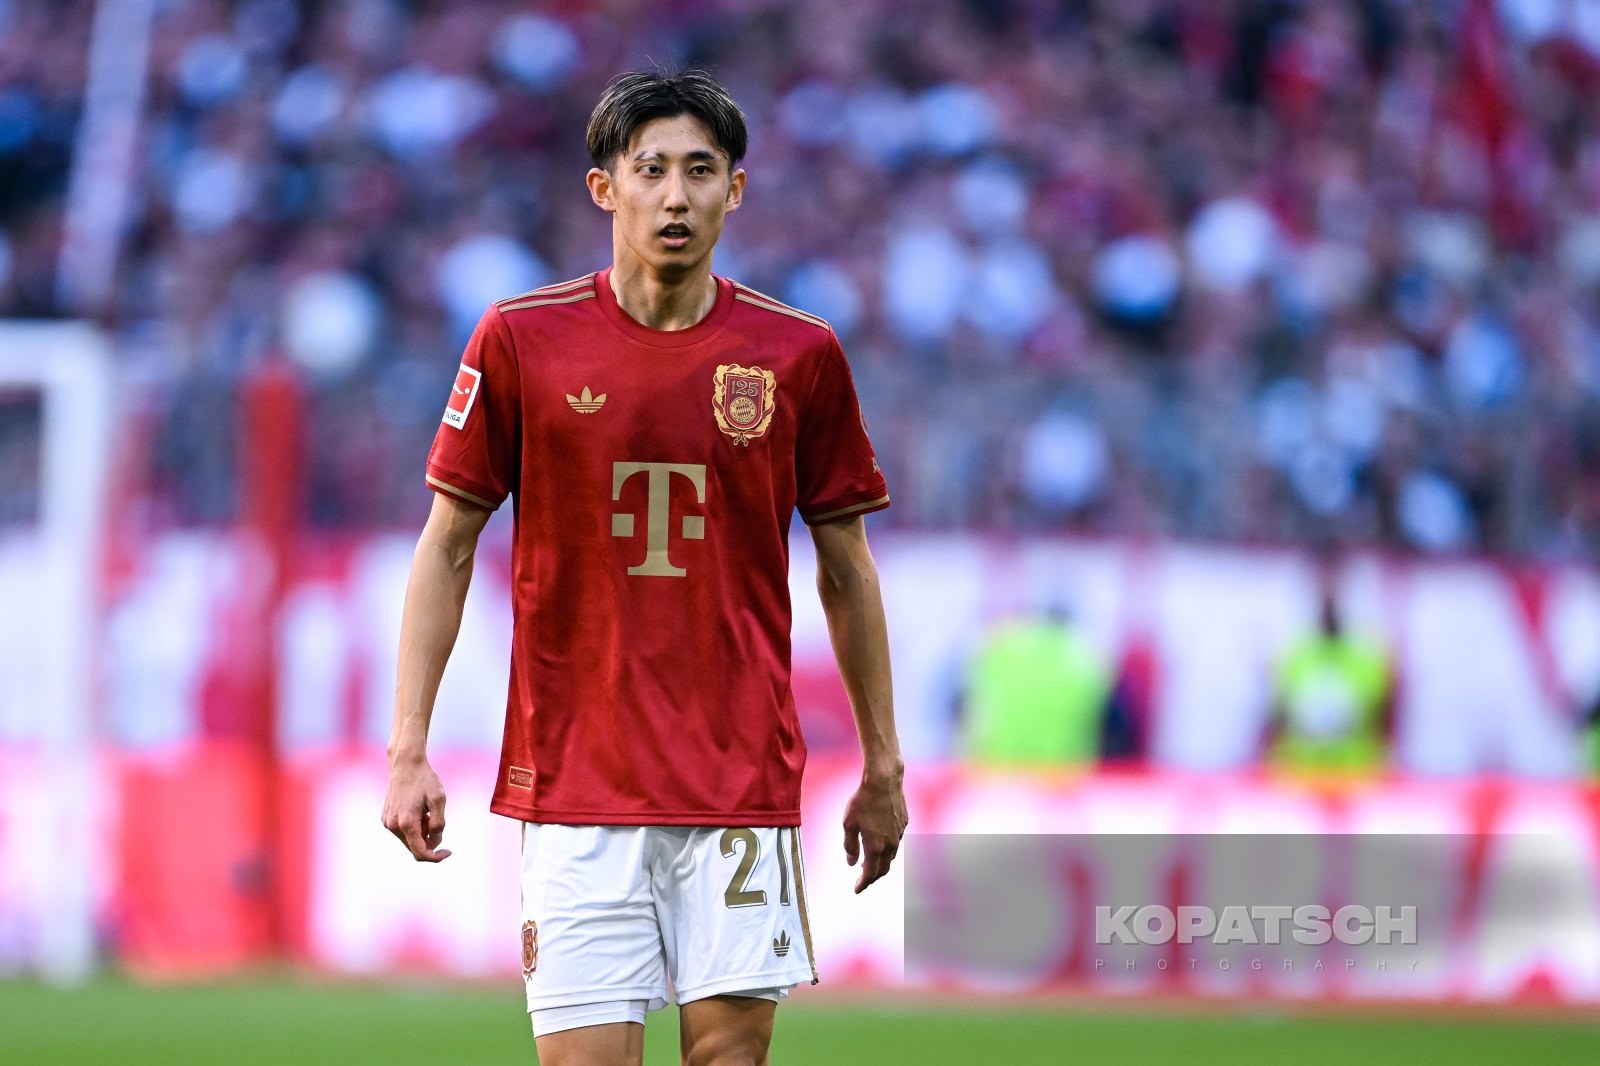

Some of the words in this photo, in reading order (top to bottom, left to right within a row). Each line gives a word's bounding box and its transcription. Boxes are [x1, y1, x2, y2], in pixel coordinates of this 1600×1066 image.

[731, 379, 759, 397] 125
[611, 461, 707, 577] T
[719, 826, 791, 910] 21
